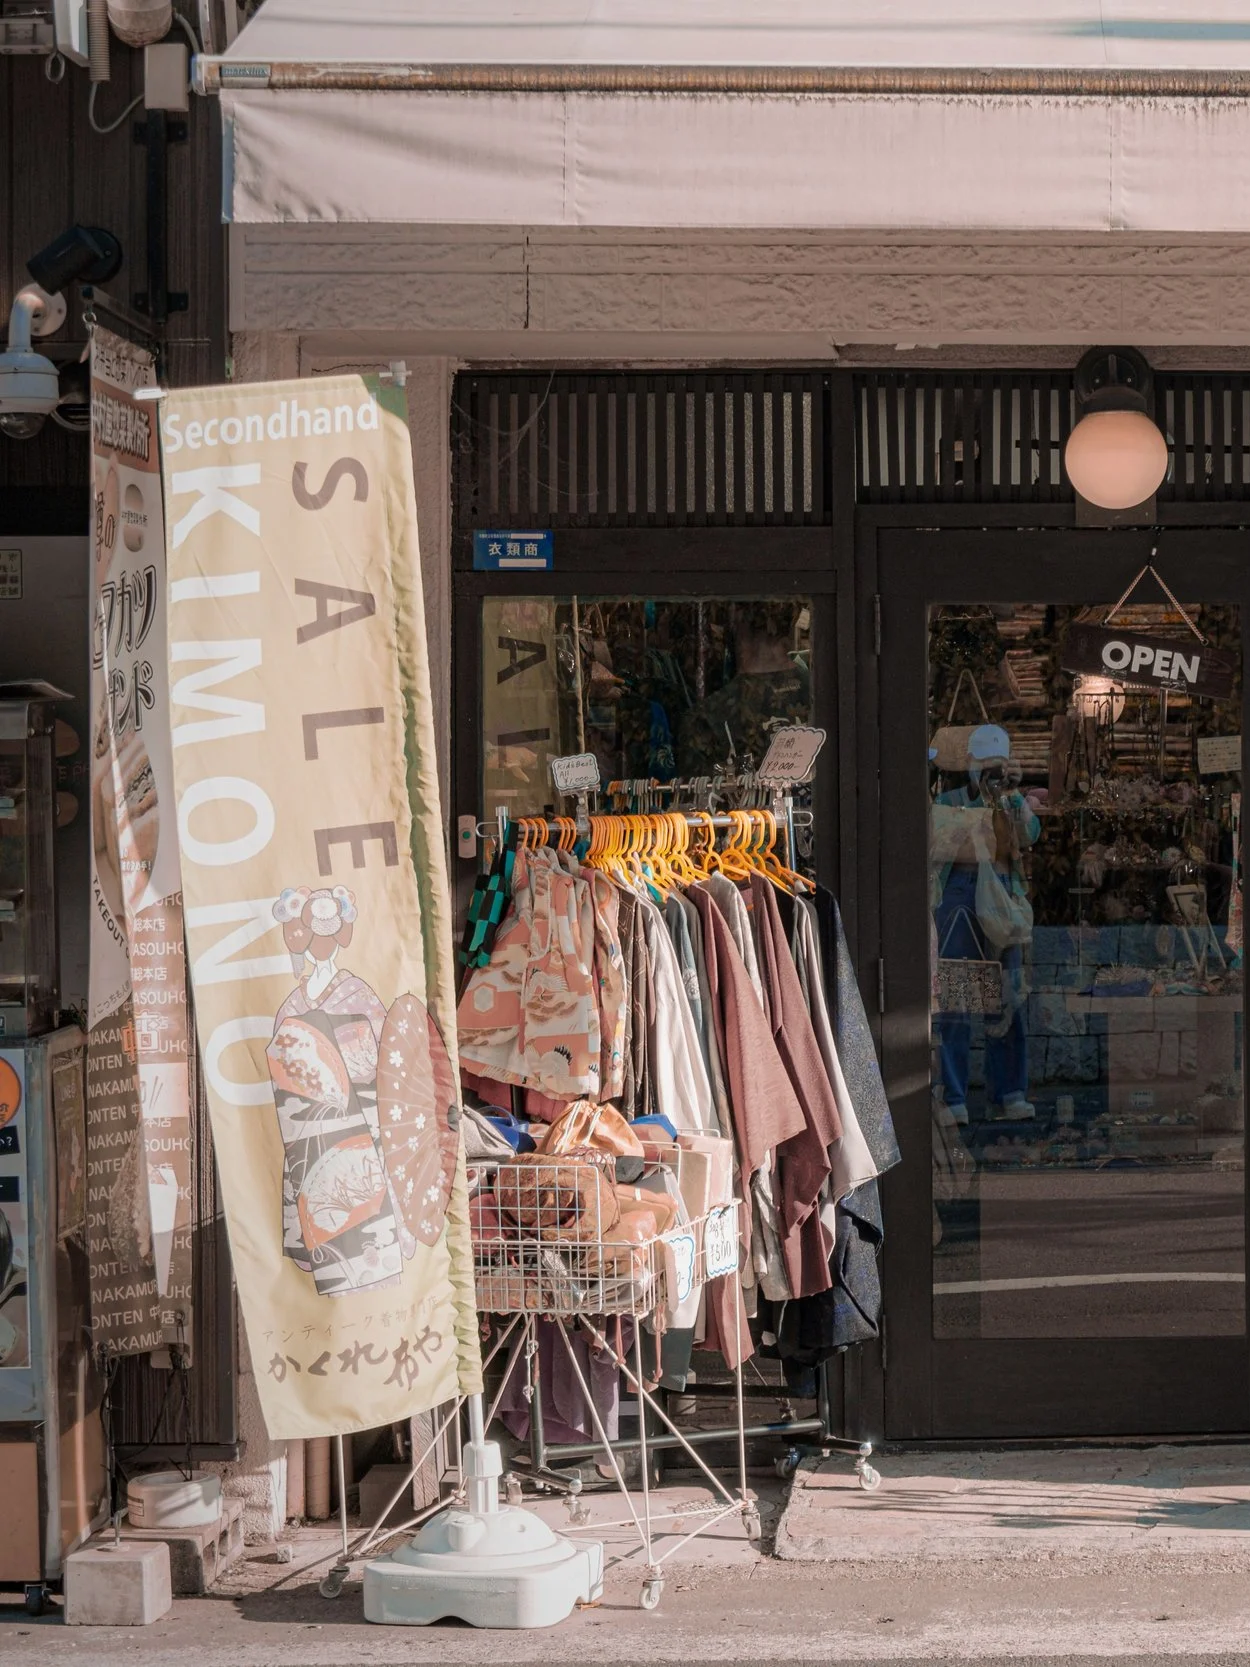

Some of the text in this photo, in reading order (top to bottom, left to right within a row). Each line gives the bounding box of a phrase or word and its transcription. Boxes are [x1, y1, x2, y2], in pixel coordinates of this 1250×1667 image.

[163, 397, 379, 454] Secondhand
[488, 542, 538, 556] 衣類商
[292, 457, 400, 877] SALE
[1102, 641, 1200, 683] OPEN
[171, 462, 295, 1106] KIMONO
[93, 875, 125, 947] TAKEOUT
